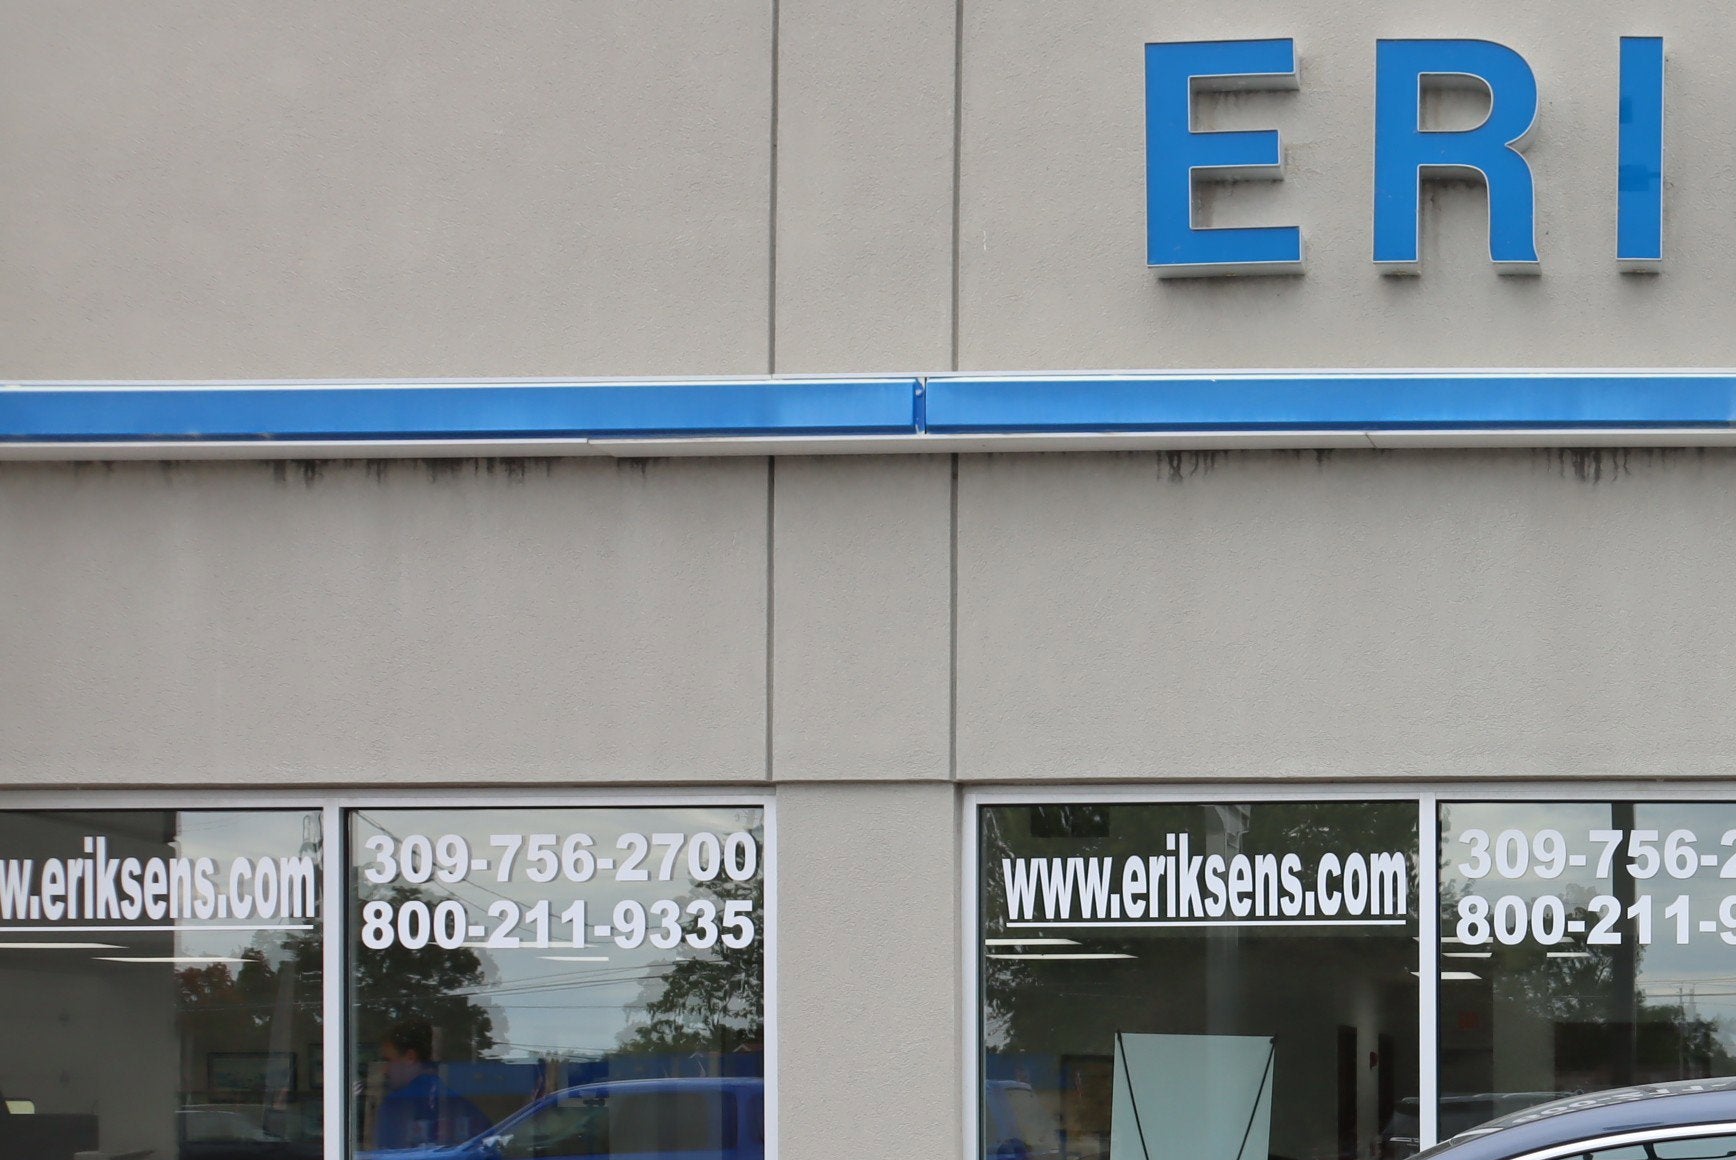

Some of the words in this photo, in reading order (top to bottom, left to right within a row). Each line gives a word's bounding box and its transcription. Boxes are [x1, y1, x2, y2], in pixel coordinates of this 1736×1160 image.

[364, 832, 757, 883] 309-756-2700
[1003, 834, 1407, 920] www.eriksens.com
[361, 899, 754, 949] 800-211-9335
